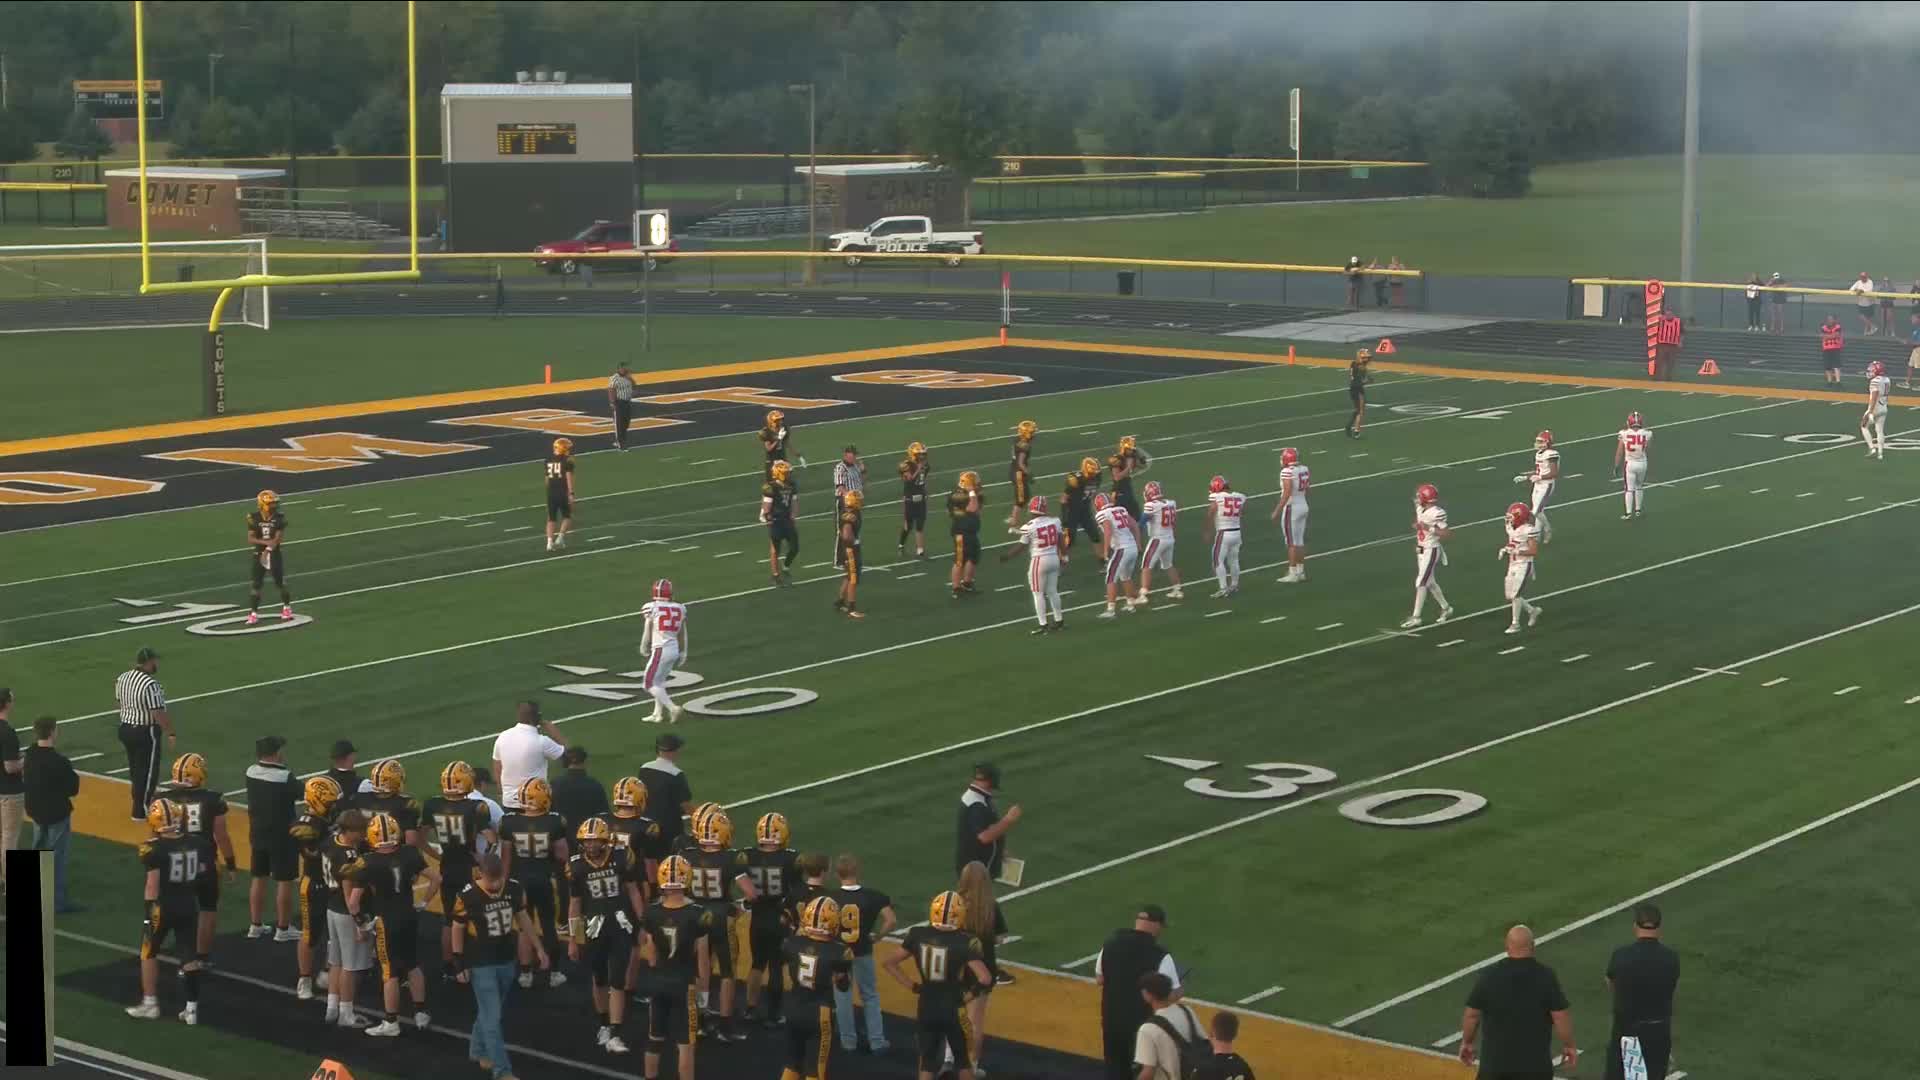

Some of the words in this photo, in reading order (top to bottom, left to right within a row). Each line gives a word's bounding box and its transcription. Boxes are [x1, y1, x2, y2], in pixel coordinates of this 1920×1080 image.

[127, 181, 217, 206] COMET
[876, 243, 929, 253] POLICE
[215, 334, 225, 414] COMETS
[1704, 362, 1713, 373] 10
[1627, 435, 1647, 452] 24
[1223, 497, 1242, 517] 55
[1037, 525, 1057, 548] 58
[658, 606, 682, 632] 22
[433, 816, 465, 845] 24
[169, 851, 198, 882] 60
[391, 865, 401, 894] 1
[840, 903, 860, 943] 9
[661, 927, 677, 959] 7
[798, 953, 817, 989] 2
[920, 944, 948, 981] 10
